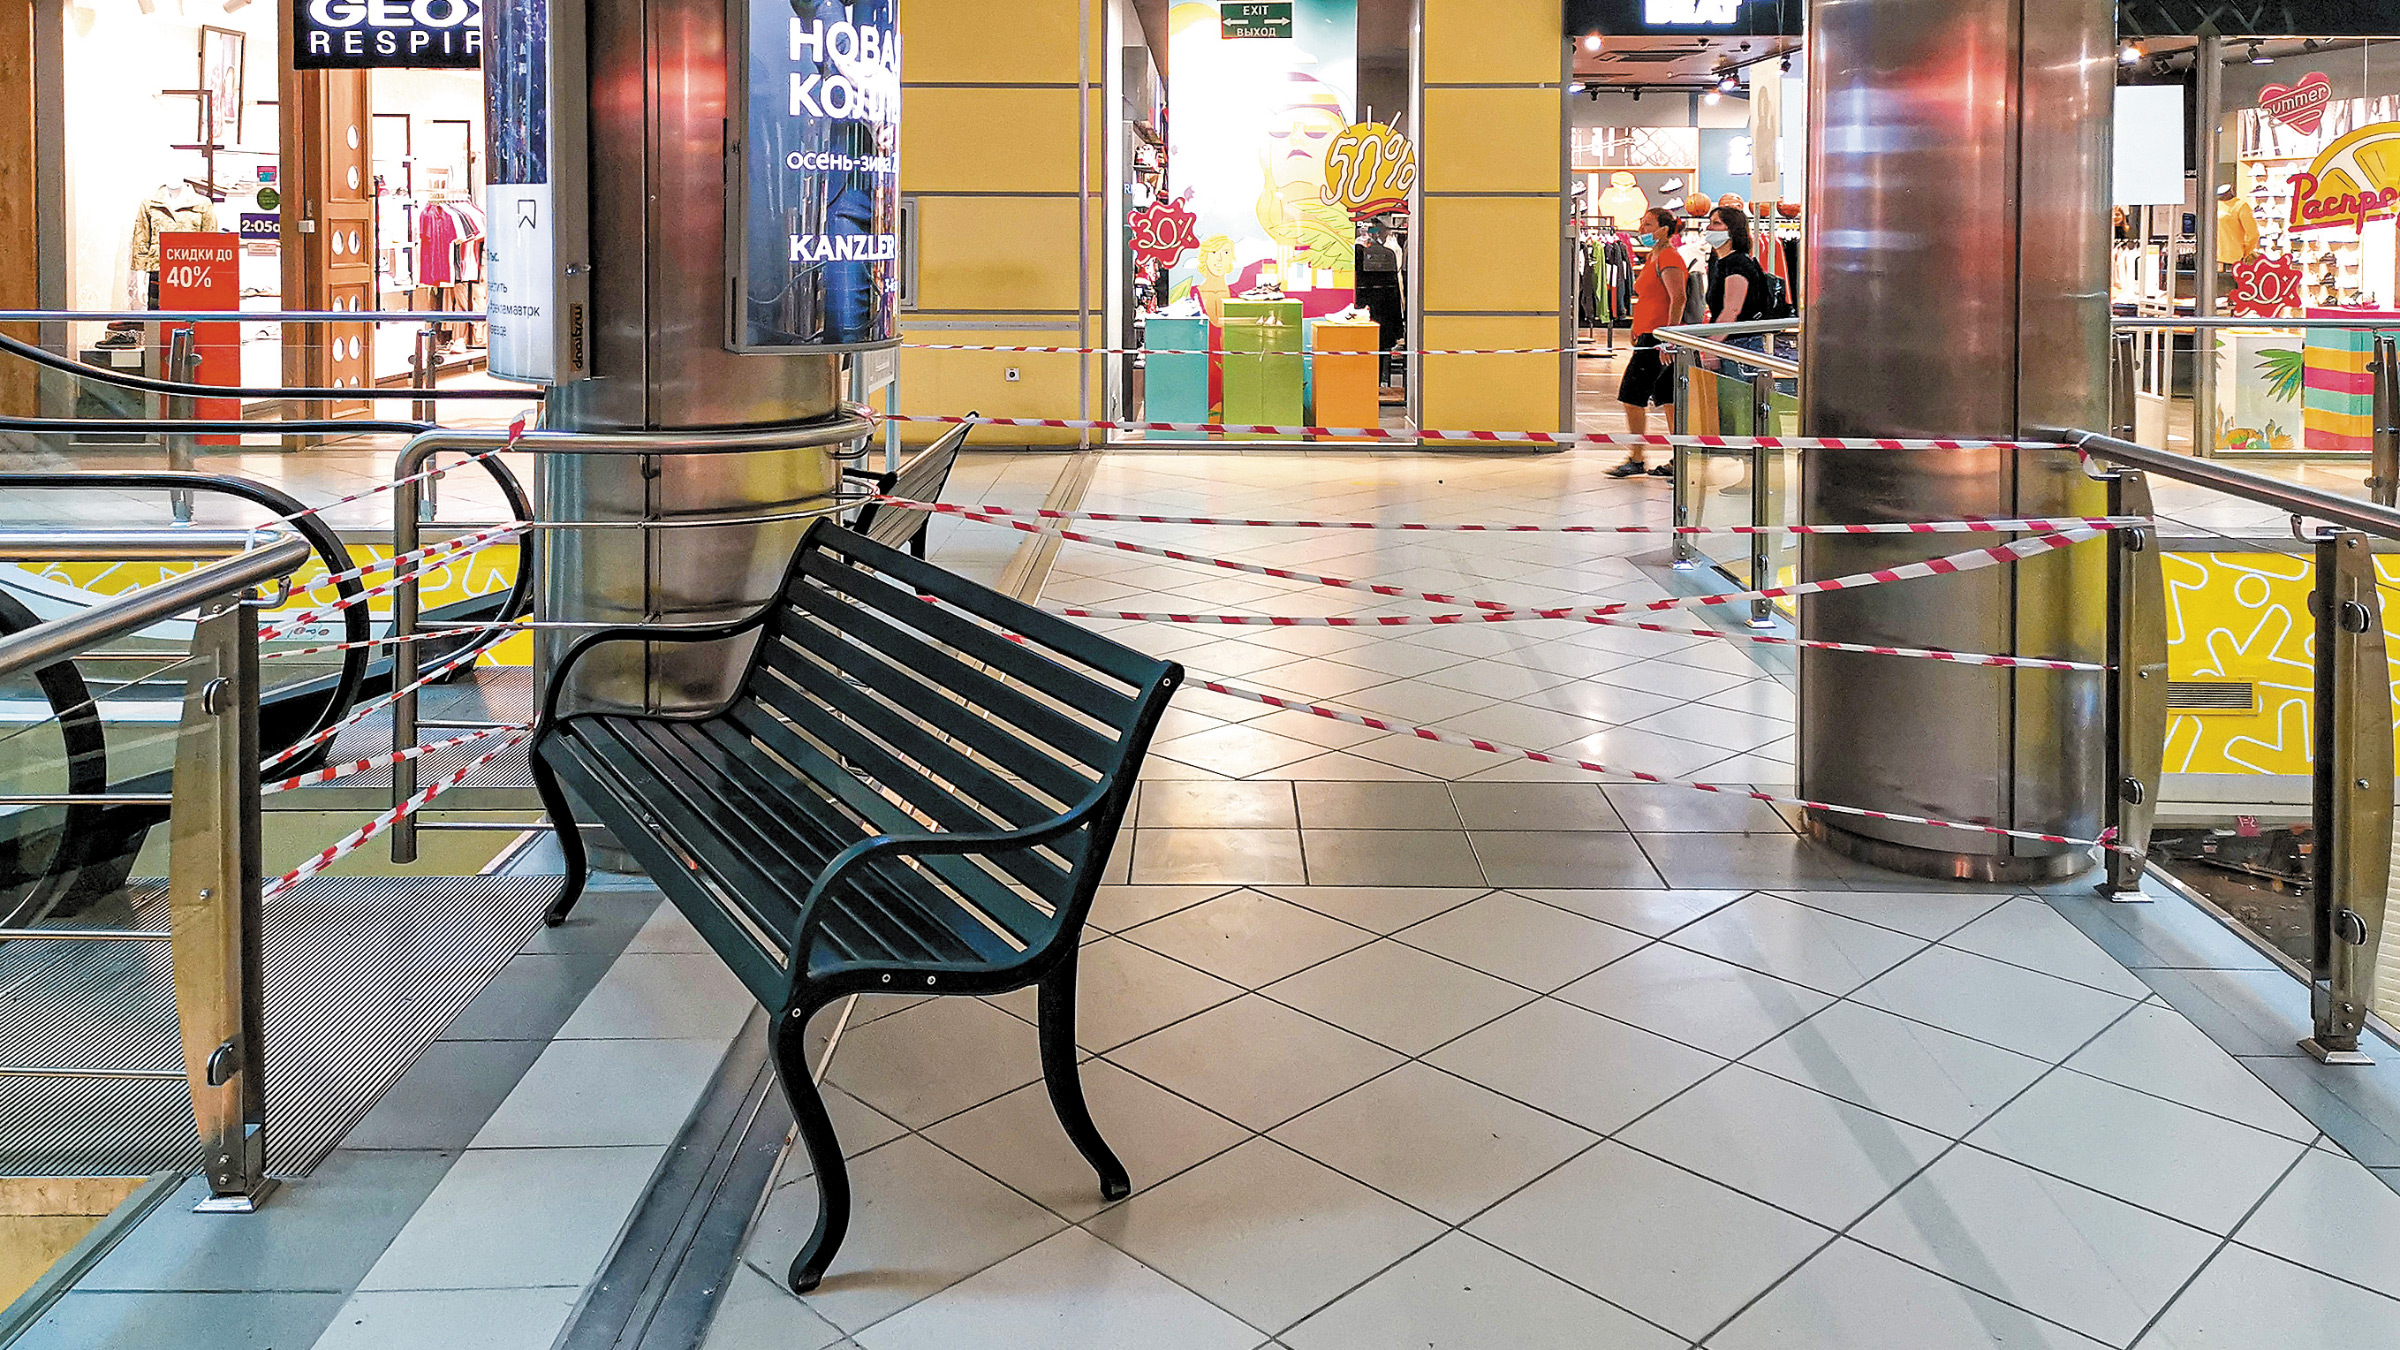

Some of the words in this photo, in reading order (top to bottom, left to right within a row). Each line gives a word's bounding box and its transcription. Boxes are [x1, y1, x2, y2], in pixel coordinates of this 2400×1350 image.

[1243, 5, 1269, 16] EXIT
[1236, 27, 1277, 37] ВЫХОД
[1320, 133, 1417, 206] 50%
[2287, 173, 2400, 235] Распро
[1137, 216, 1195, 250] 30%
[166, 248, 214, 262] СКИДКИ
[215, 248, 233, 262] ДО
[789, 234, 895, 262] KANZLER
[166, 265, 212, 288] 40%
[2238, 270, 2299, 305] 30%
